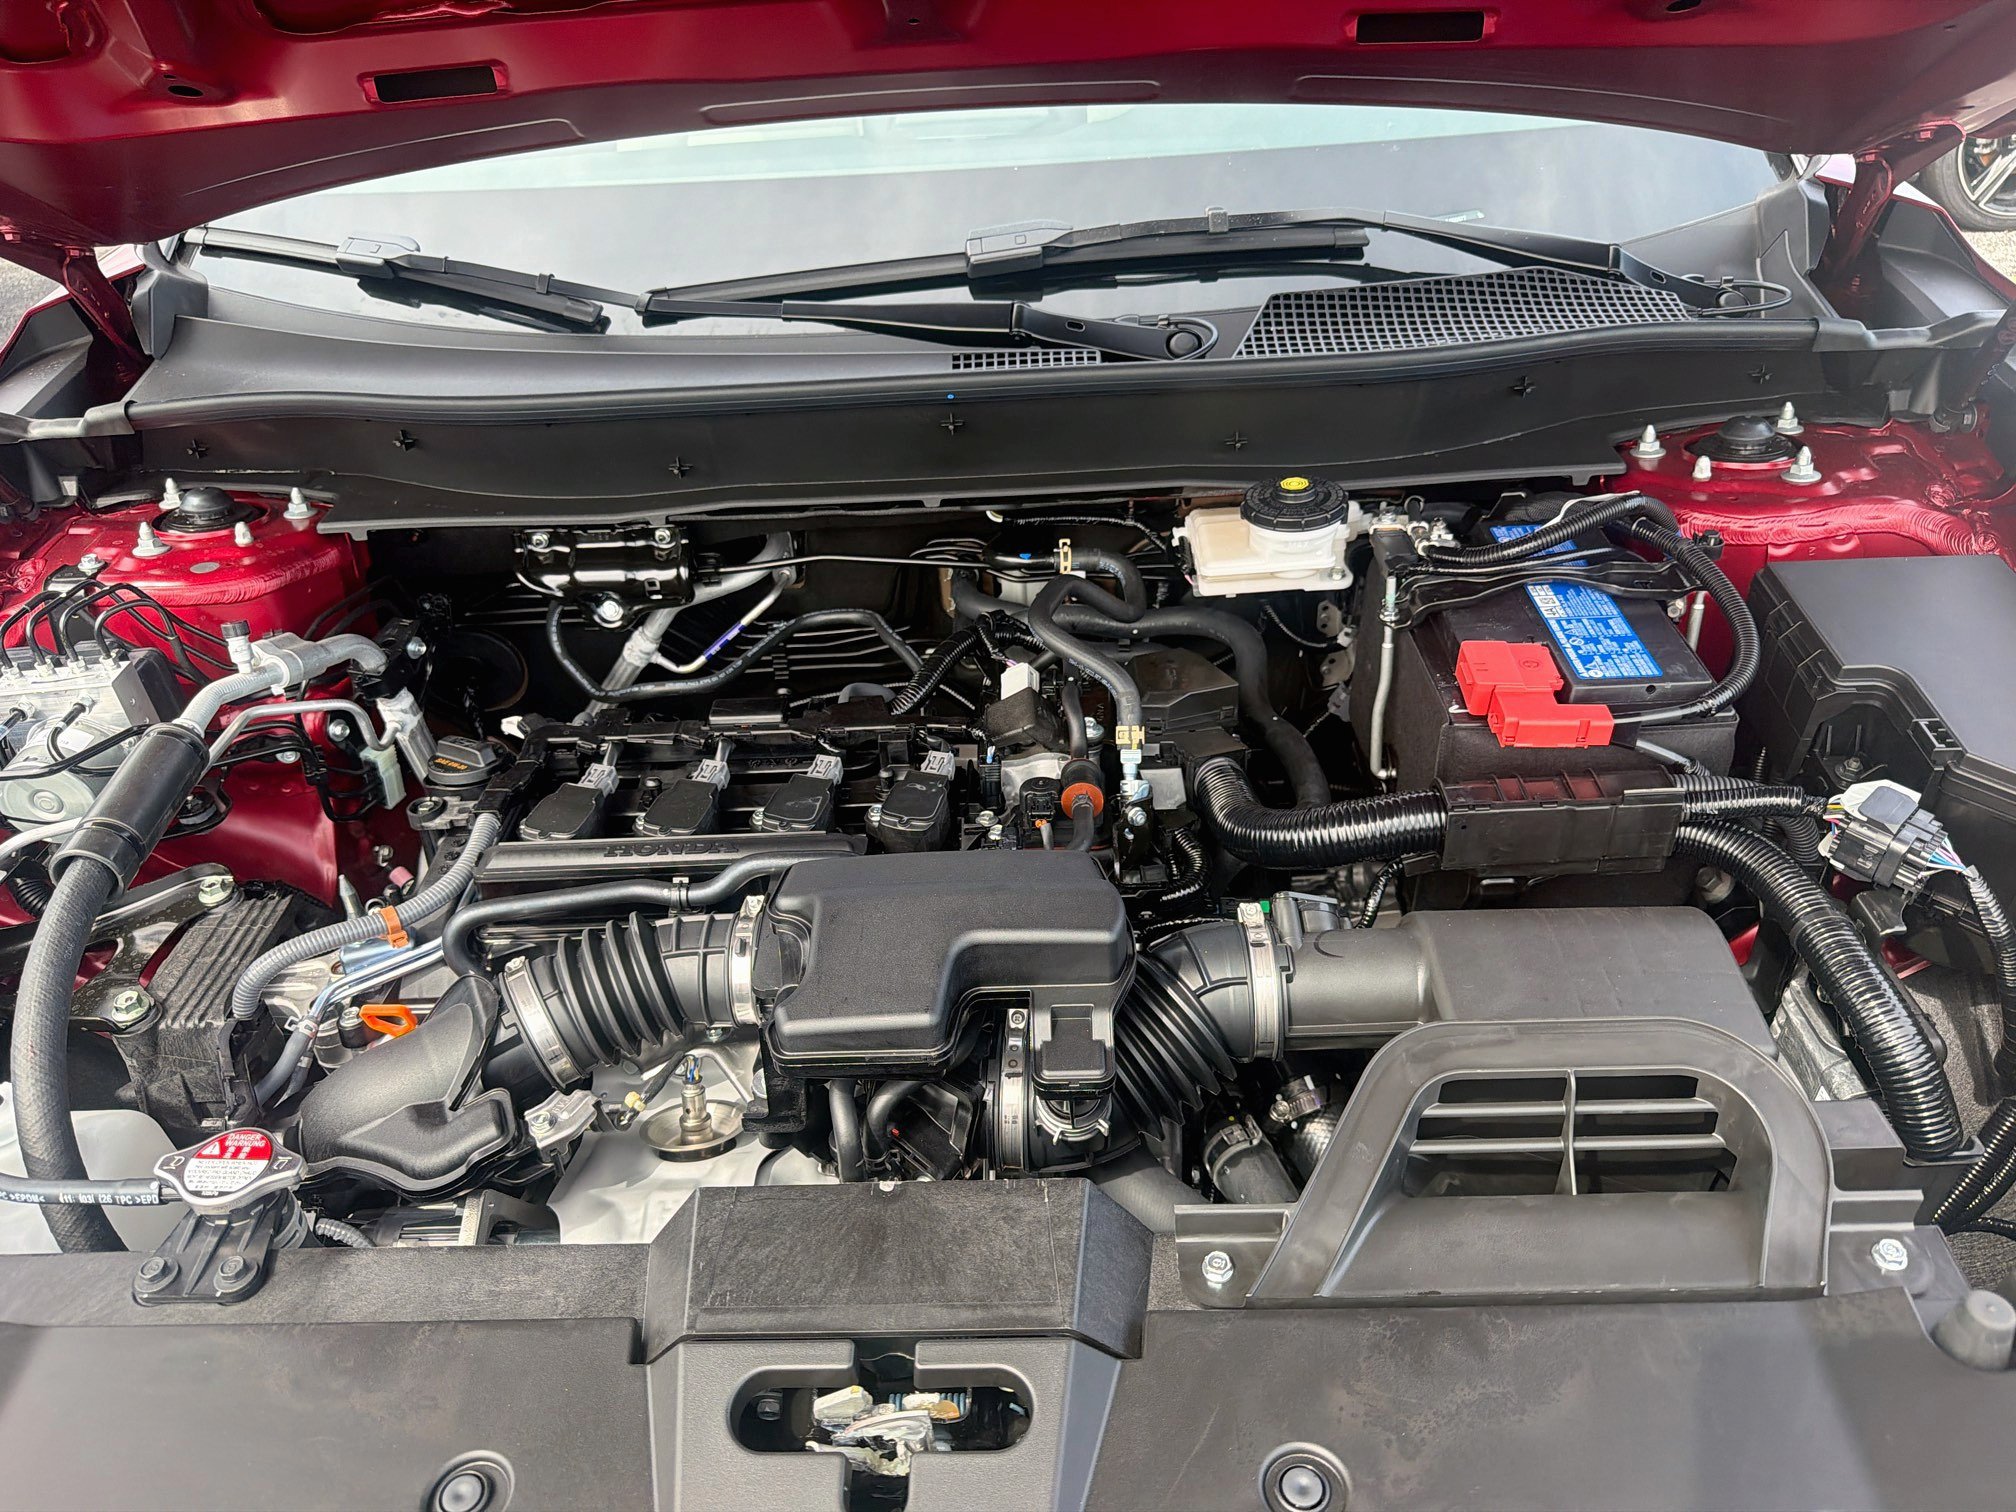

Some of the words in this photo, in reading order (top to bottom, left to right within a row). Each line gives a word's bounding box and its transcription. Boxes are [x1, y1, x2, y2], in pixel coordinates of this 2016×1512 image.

[604, 840, 739, 857] HONDA
[228, 1132, 263, 1141] DANGER
[225, 1139, 266, 1148] WARNUNG
[114, 1195, 133, 1205] TPC
